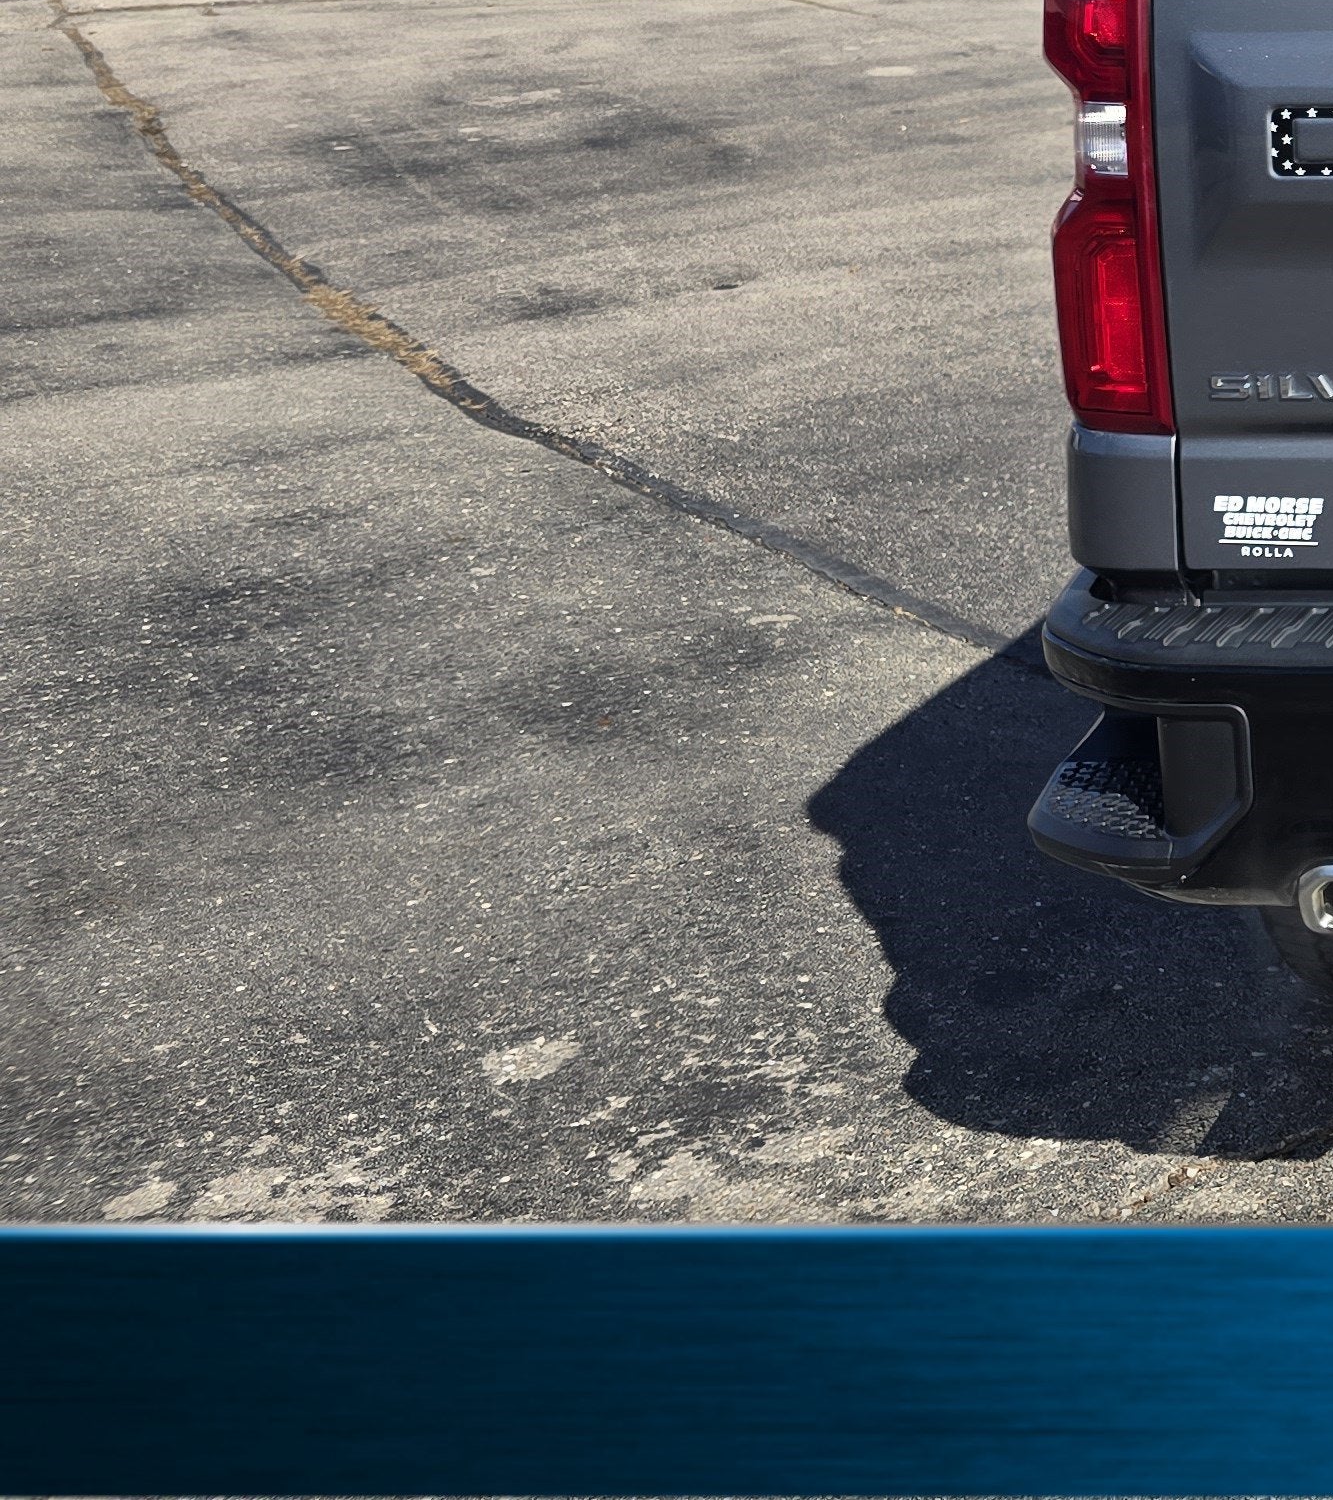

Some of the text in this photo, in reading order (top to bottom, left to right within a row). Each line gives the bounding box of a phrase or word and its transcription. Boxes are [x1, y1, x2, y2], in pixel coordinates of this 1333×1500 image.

[1213, 495, 1325, 515] ED MORSE
[1222, 512, 1317, 528] CHEVROLET
[1240, 545, 1294, 558] ROLLA
